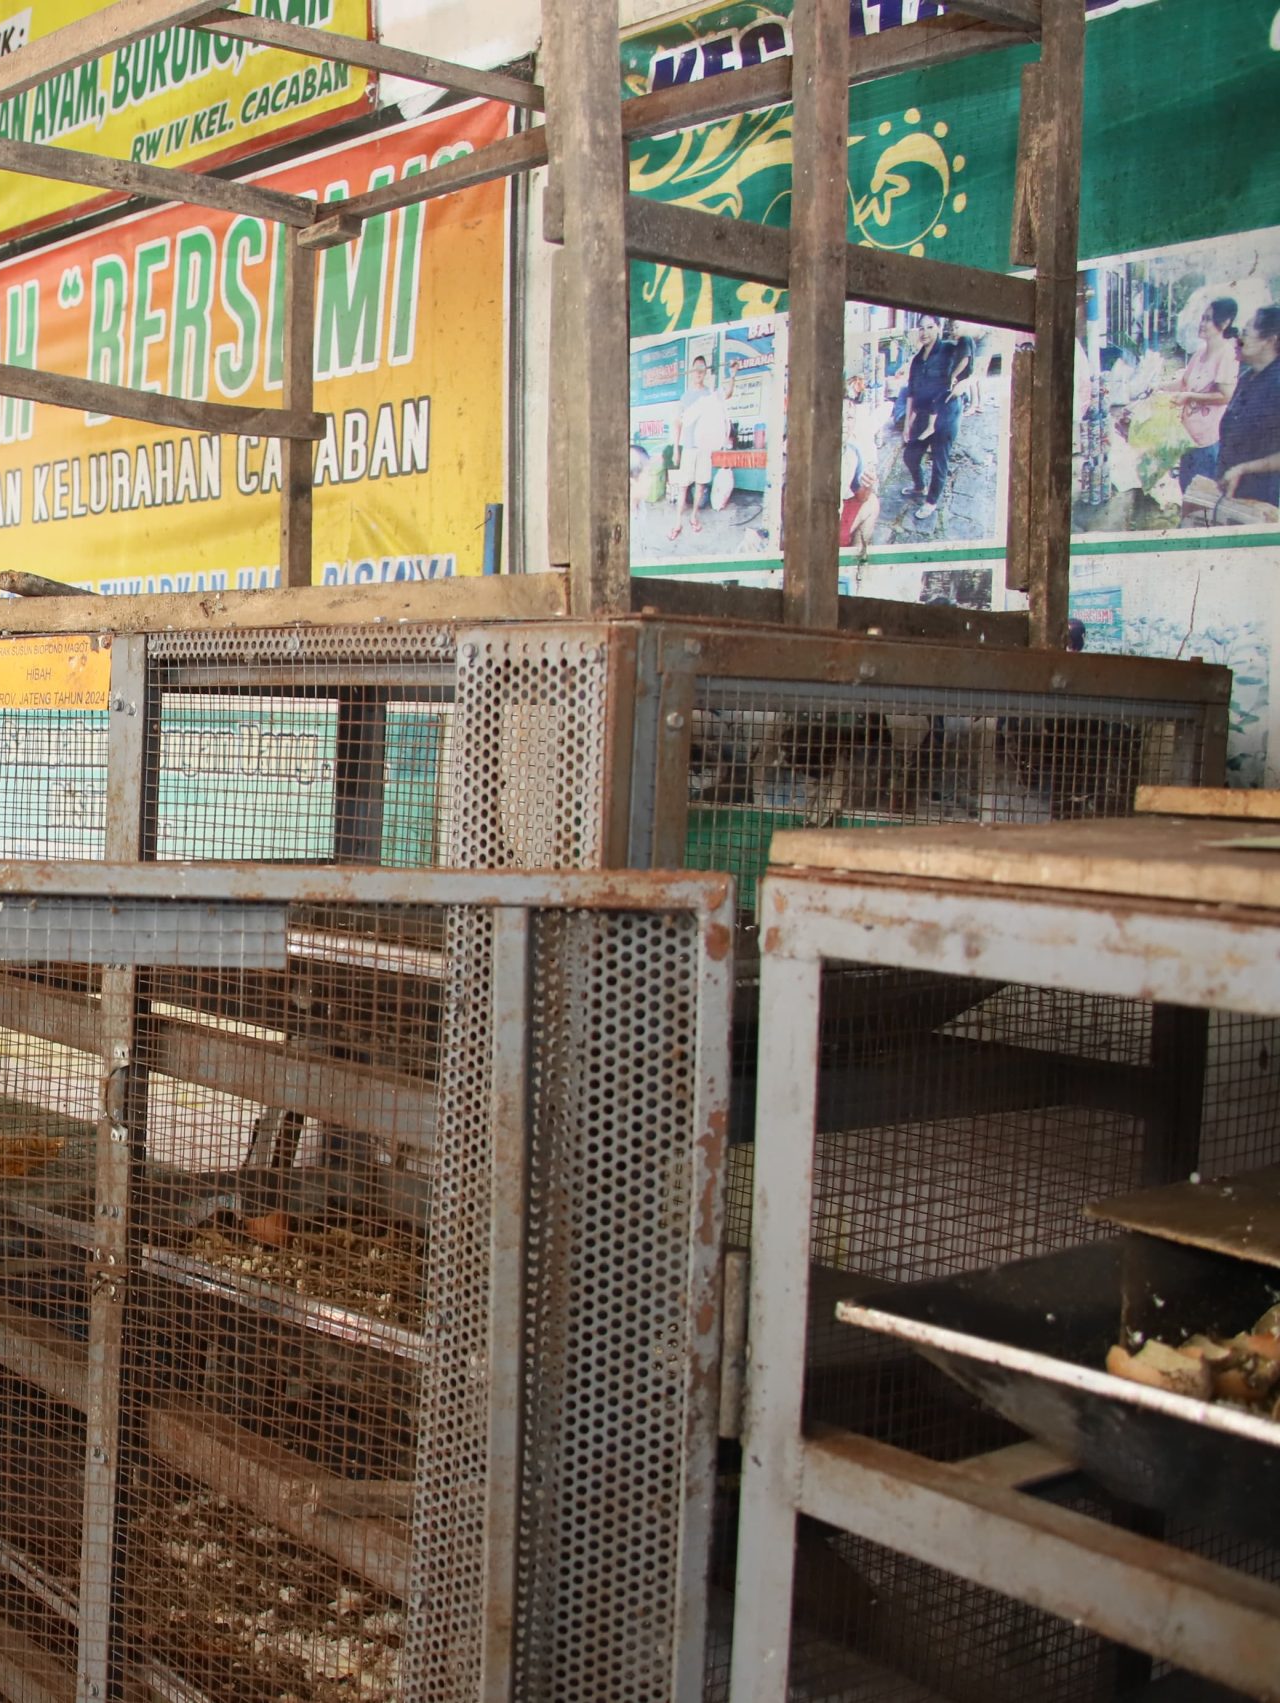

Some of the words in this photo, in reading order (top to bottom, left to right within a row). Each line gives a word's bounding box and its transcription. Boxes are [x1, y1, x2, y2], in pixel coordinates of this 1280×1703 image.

[132, 128, 164, 164] RW
[166, 117, 189, 155] IV
[190, 101, 234, 144] KEL.
[241, 62, 349, 124] CACABAN
[32, 432, 222, 523] KELURAHAN
[236, 395, 432, 495] CAABAN
[11, 645, 33, 656] SUSUN
[26, 668, 52, 681] HIBAH
[19, 692, 52, 706] JATENG
[53, 691, 84, 706] TAHUN
[85, 691, 106, 705] 2024
